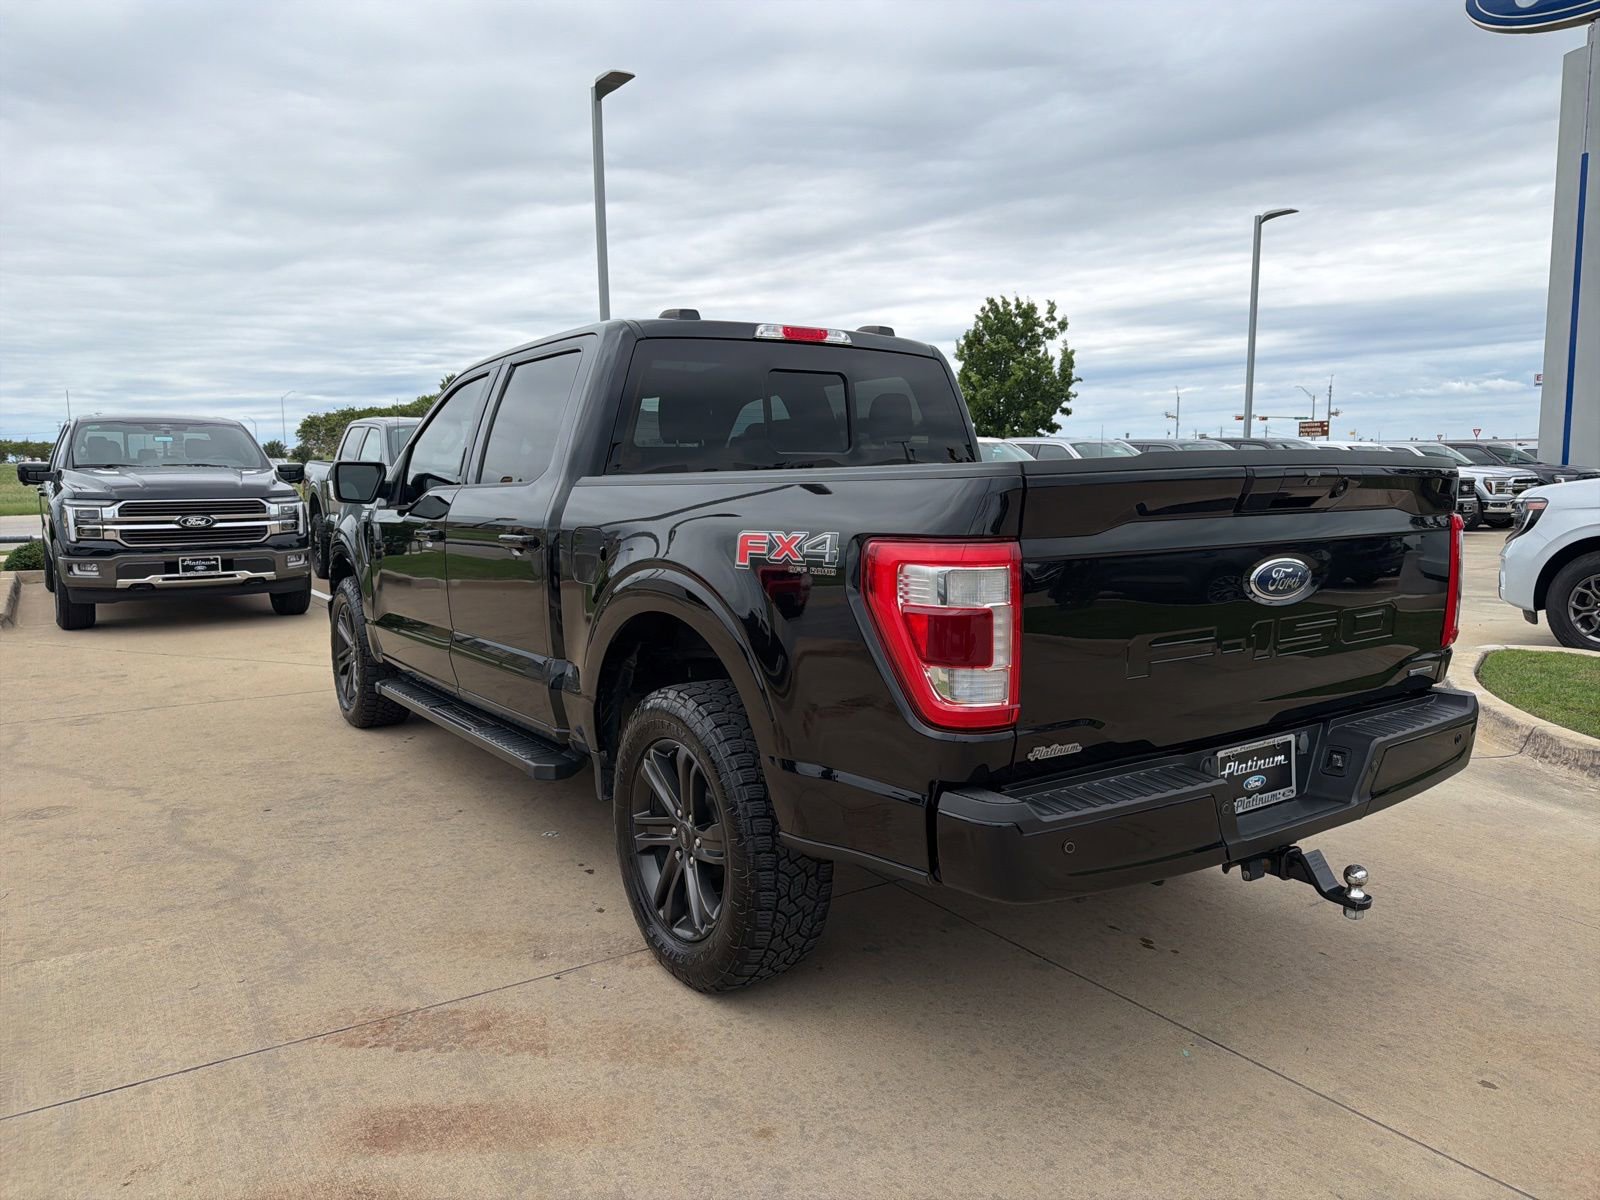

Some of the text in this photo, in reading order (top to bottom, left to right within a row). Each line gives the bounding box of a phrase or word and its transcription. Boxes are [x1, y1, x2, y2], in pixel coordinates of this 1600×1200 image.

[735, 530, 839, 569] FX4
[788, 566, 808, 574] OFF
[1267, 567, 1302, 592] Ford
[1126, 603, 1397, 680] F-150
[1028, 742, 1083, 762] Platinum
[1220, 754, 1289, 779] Platinum
[1246, 776, 1263, 789] Ford
[1235, 791, 1281, 812] Platinum
